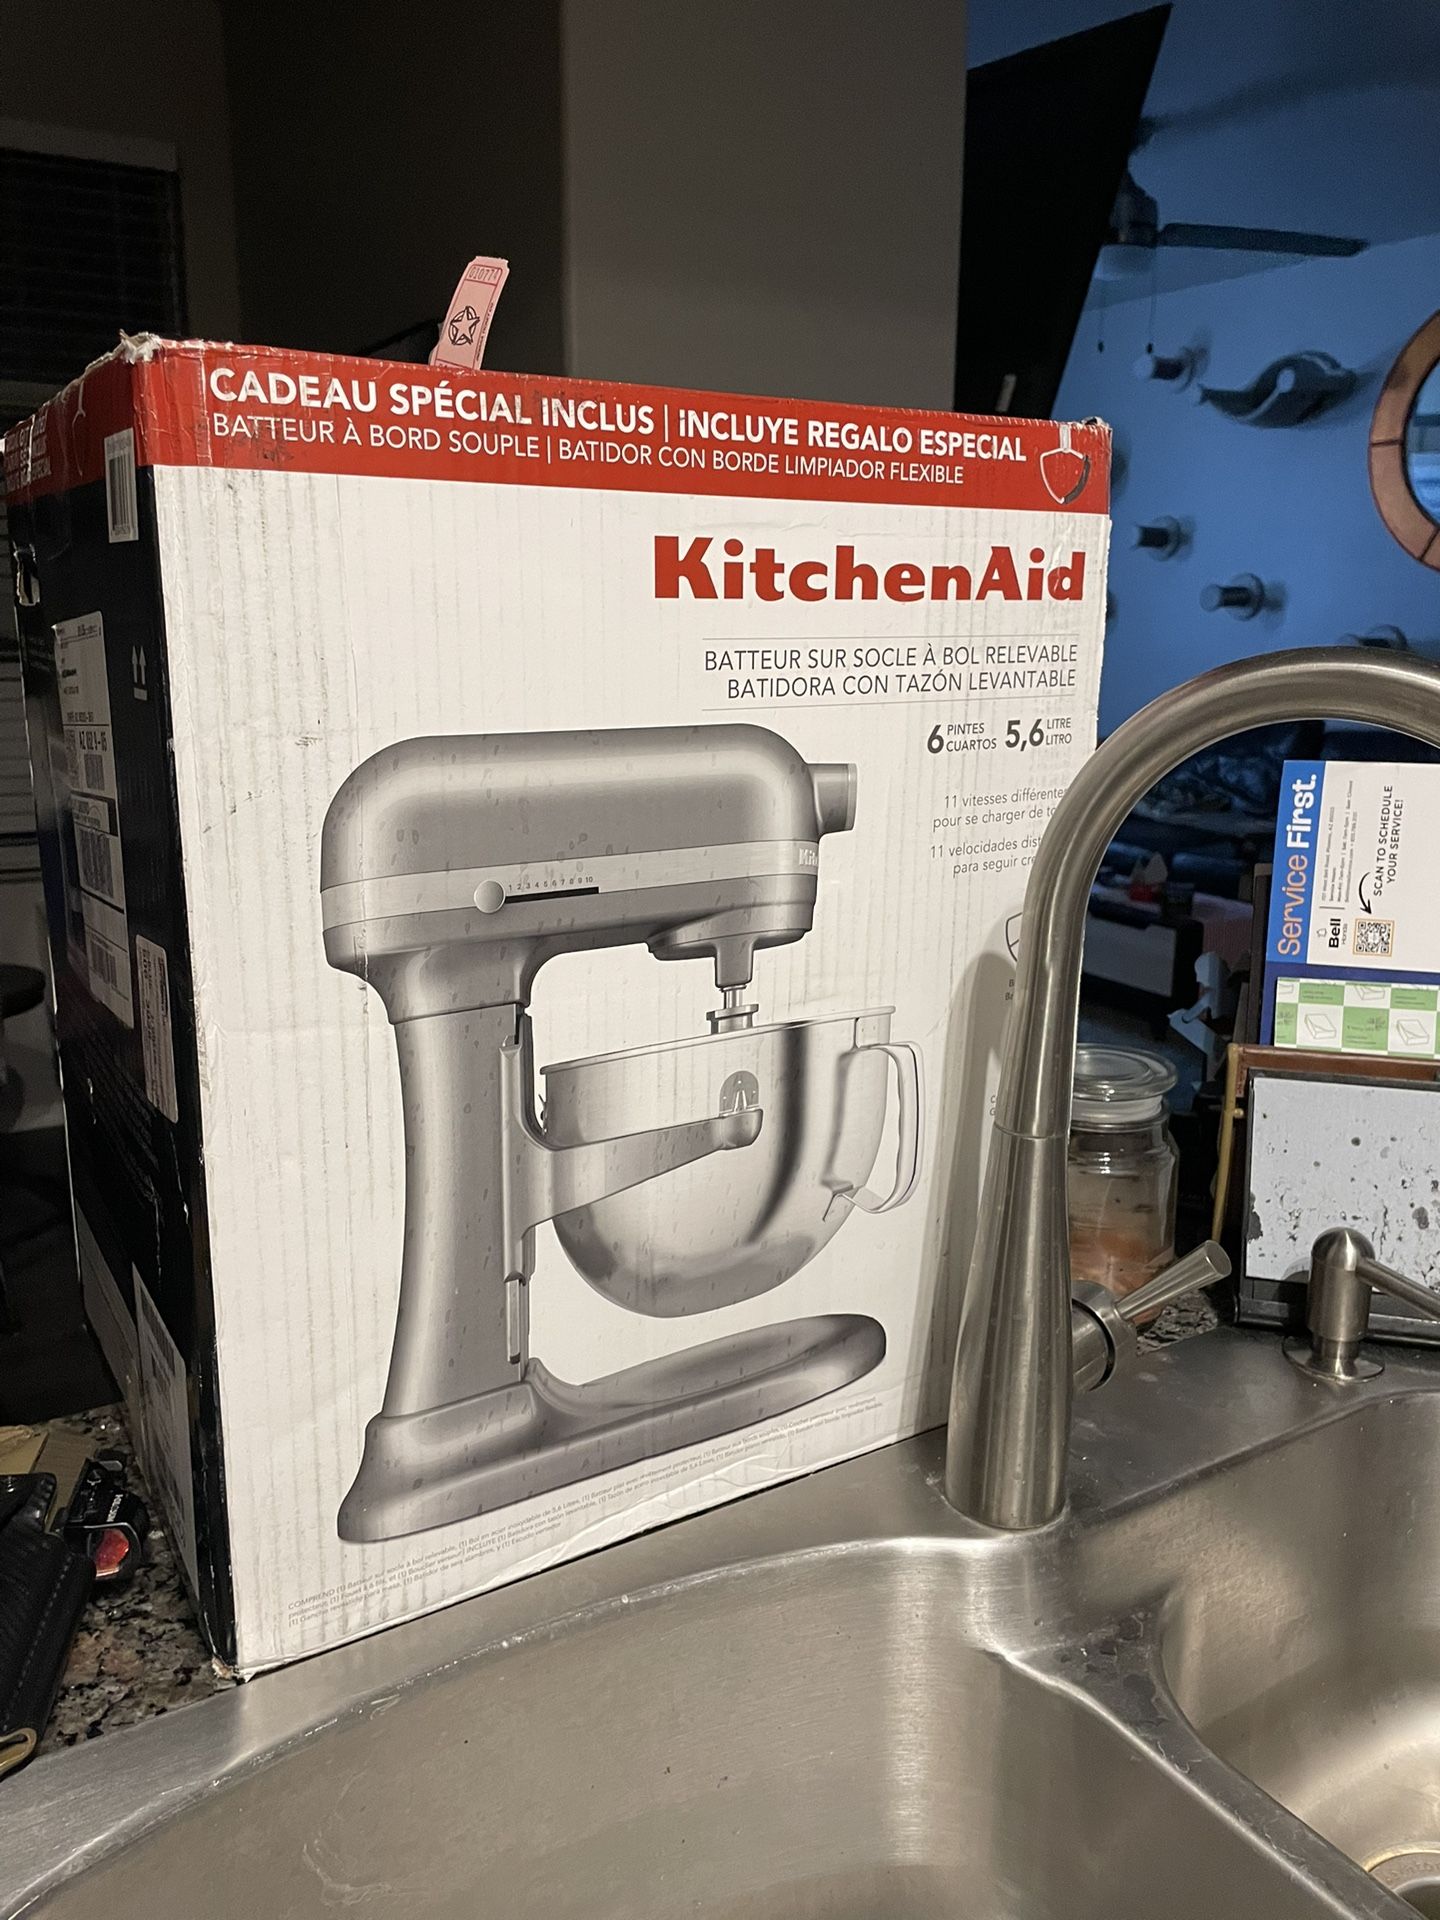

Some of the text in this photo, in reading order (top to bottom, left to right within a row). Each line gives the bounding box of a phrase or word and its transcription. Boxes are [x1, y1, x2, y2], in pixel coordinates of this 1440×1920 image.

[209, 367, 377, 413] CADEAU
[389, 380, 532, 425] SPÉCIAL
[542, 397, 655, 435] INCLUS
[679, 408, 799, 446] INCLUYE
[807, 420, 913, 453] REGALO
[920, 429, 1027, 462] ESPECIAL
[212, 412, 335, 444] BATTEUR
[342, 417, 362, 446] À
[370, 424, 441, 451] BORD
[448, 430, 540, 458] SOUPLE
[559, 438, 652, 466] BATIDOR
[658, 446, 706, 469] CON
[713, 450, 779, 474] BORDE
[785, 454, 885, 480] LIMPIADOR
[890, 462, 964, 484] FLEXIBLE
[654, 535, 1086, 602] KitchenAid
[705, 643, 1078, 671] BATTEUR SUR SOCLE À BOL RELEVABLE
[728, 669, 1076, 699] BATIDORA CON TAZÓN LEVANTABLE
[927, 723, 985, 754] 6 PINTES
[946, 738, 998, 753] CUARTOS
[1005, 718, 1072, 752] 5,6 LITRE
[1045, 733, 1072, 746] LITRO
[944, 795, 957, 809] 11
[962, 793, 1007, 807] vitesses
[933, 816, 962, 833] pour
[965, 815, 978, 826] se
[982, 809, 1026, 825] charger
[1028, 805, 1043, 819] de
[930, 845, 943, 858] 11
[949, 837, 1018, 857] velocidades
[1374, 785, 1393, 896] SCAN TO SCHEDULE
[1387, 799, 1403, 884] YOUR SERVICE!
[953, 862, 979, 878] para
[982, 855, 1018, 873] seguir
[1277, 774, 1317, 956] Service First.
[1329, 918, 1342, 949] Bell
[288, 1588, 335, 1610] COMPREND
